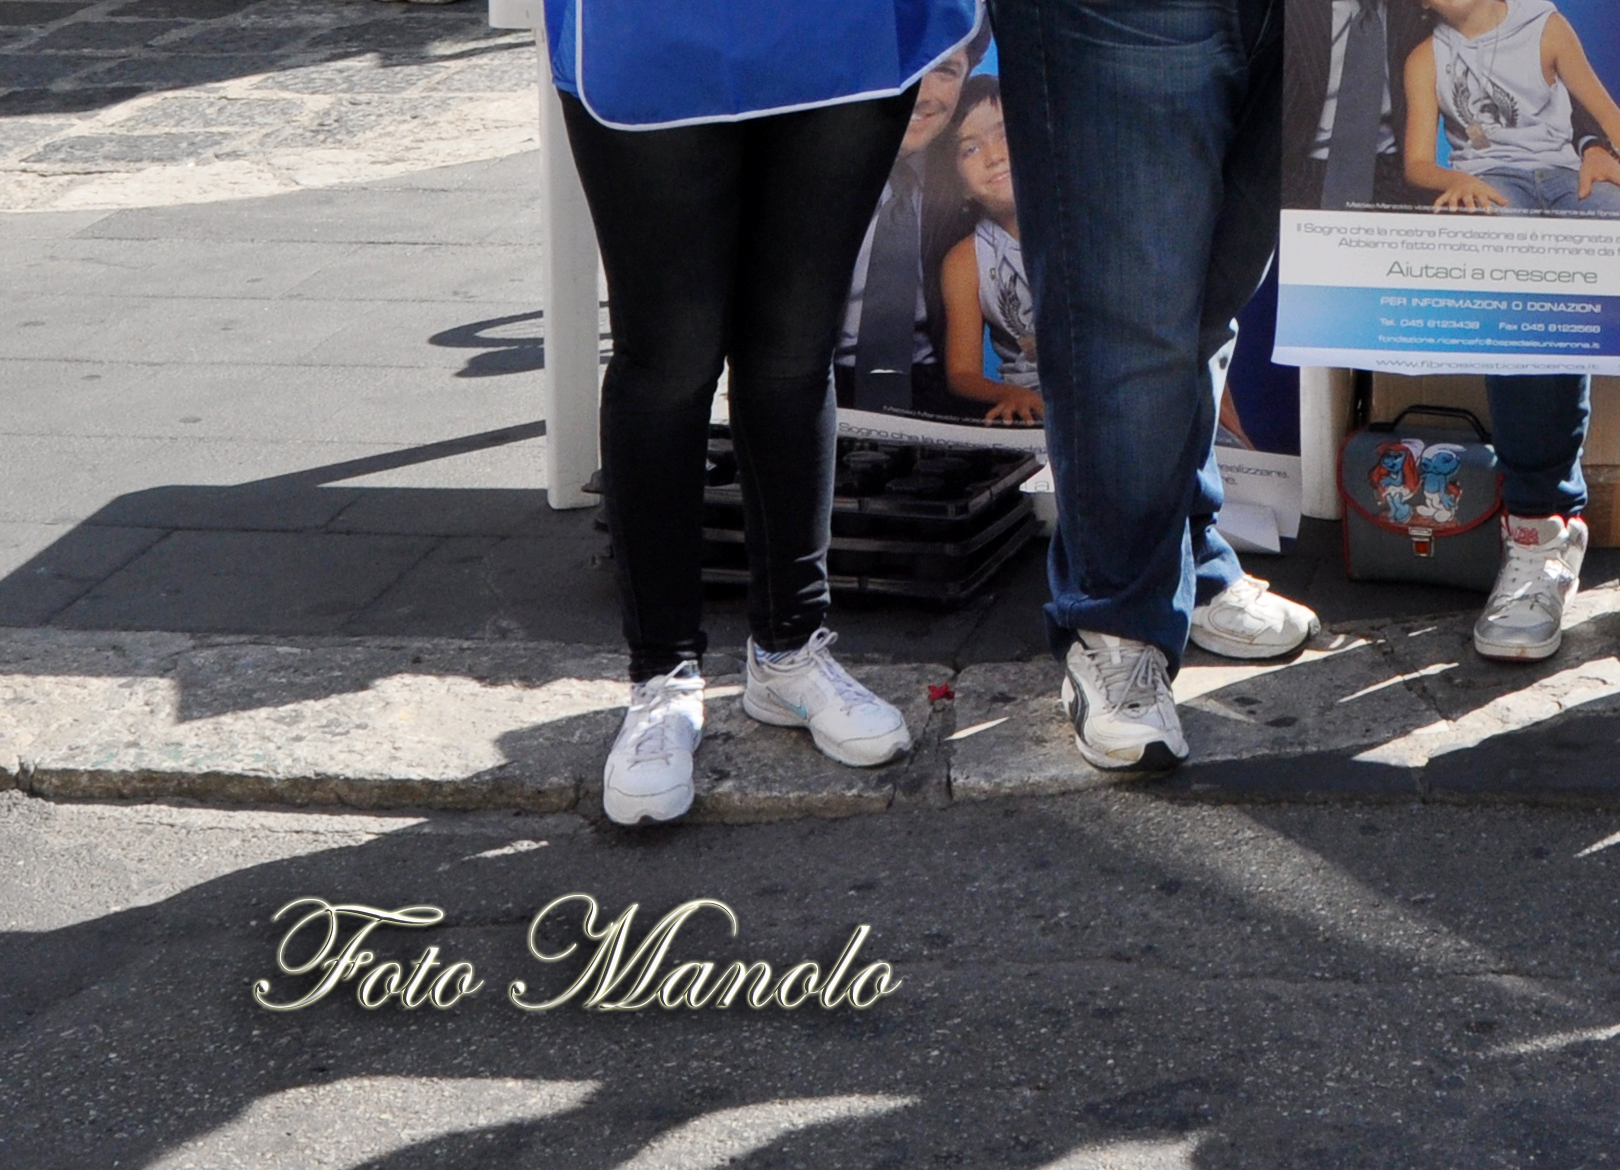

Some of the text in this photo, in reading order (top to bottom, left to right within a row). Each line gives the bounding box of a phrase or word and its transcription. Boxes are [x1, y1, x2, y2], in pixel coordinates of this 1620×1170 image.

[1304, 222, 1347, 236] Sogno
[1350, 224, 1374, 236] che
[1377, 224, 1393, 236] la
[1395, 227, 1436, 238] nostra
[1438, 228, 1515, 242] Fondazione
[1517, 231, 1527, 241] si
[1530, 230, 1538, 242] è
[1541, 232, 1613, 245] impegnata
[1338, 236, 1399, 249] Abbiamo
[1401, 239, 1436, 250] fatto
[1438, 240, 1480, 253] molto,
[1482, 243, 1503, 253] ma
[1506, 242, 1545, 254] molto
[1548, 243, 1595, 256] rimane
[1598, 246, 1615, 257] da
[1386, 261, 1598, 284] Aiutaci a crescere
[1380, 296, 1602, 314] PER INFORMAZIONI O DONAZIONI
[1400, 319, 1424, 328] 045
[1499, 322, 1517, 331] Fax
[1521, 322, 1545, 333] 045
